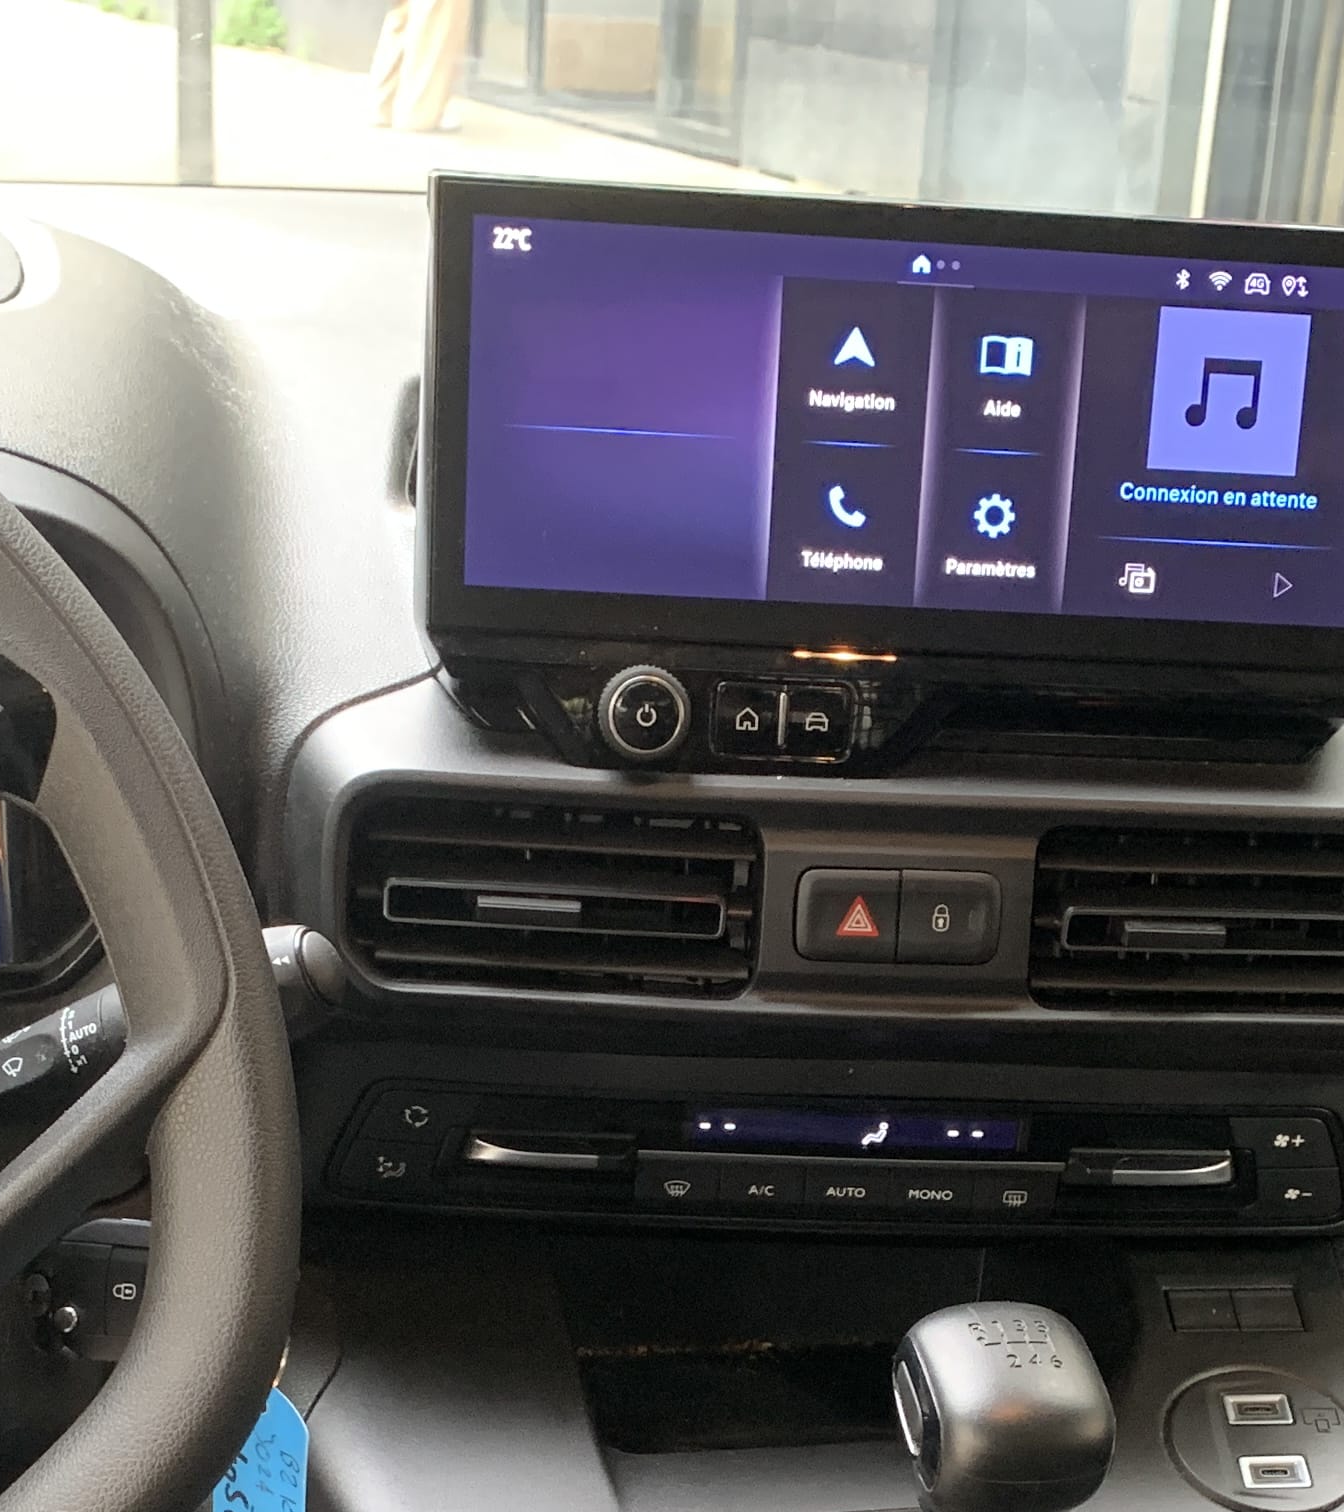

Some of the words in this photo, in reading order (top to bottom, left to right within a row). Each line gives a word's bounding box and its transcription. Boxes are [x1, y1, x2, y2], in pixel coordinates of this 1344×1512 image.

[492, 226, 533, 252] 22°C
[809, 390, 896, 412] Navigation
[983, 400, 1022, 418] Aide
[1119, 482, 1219, 505] Connexion
[1223, 490, 1247, 506] en
[1250, 491, 1318, 510] attente
[801, 549, 884, 573] Téléphone
[945, 557, 1037, 579] Paramètres
[69, 1023, 97, 1042] AUTO
[748, 1184, 775, 1197] A/C
[825, 1186, 866, 1198] AUTO
[908, 1188, 953, 1201] MONO
[1006, 1354, 1023, 1368] 2
[1029, 1353, 1043, 1365] 4
